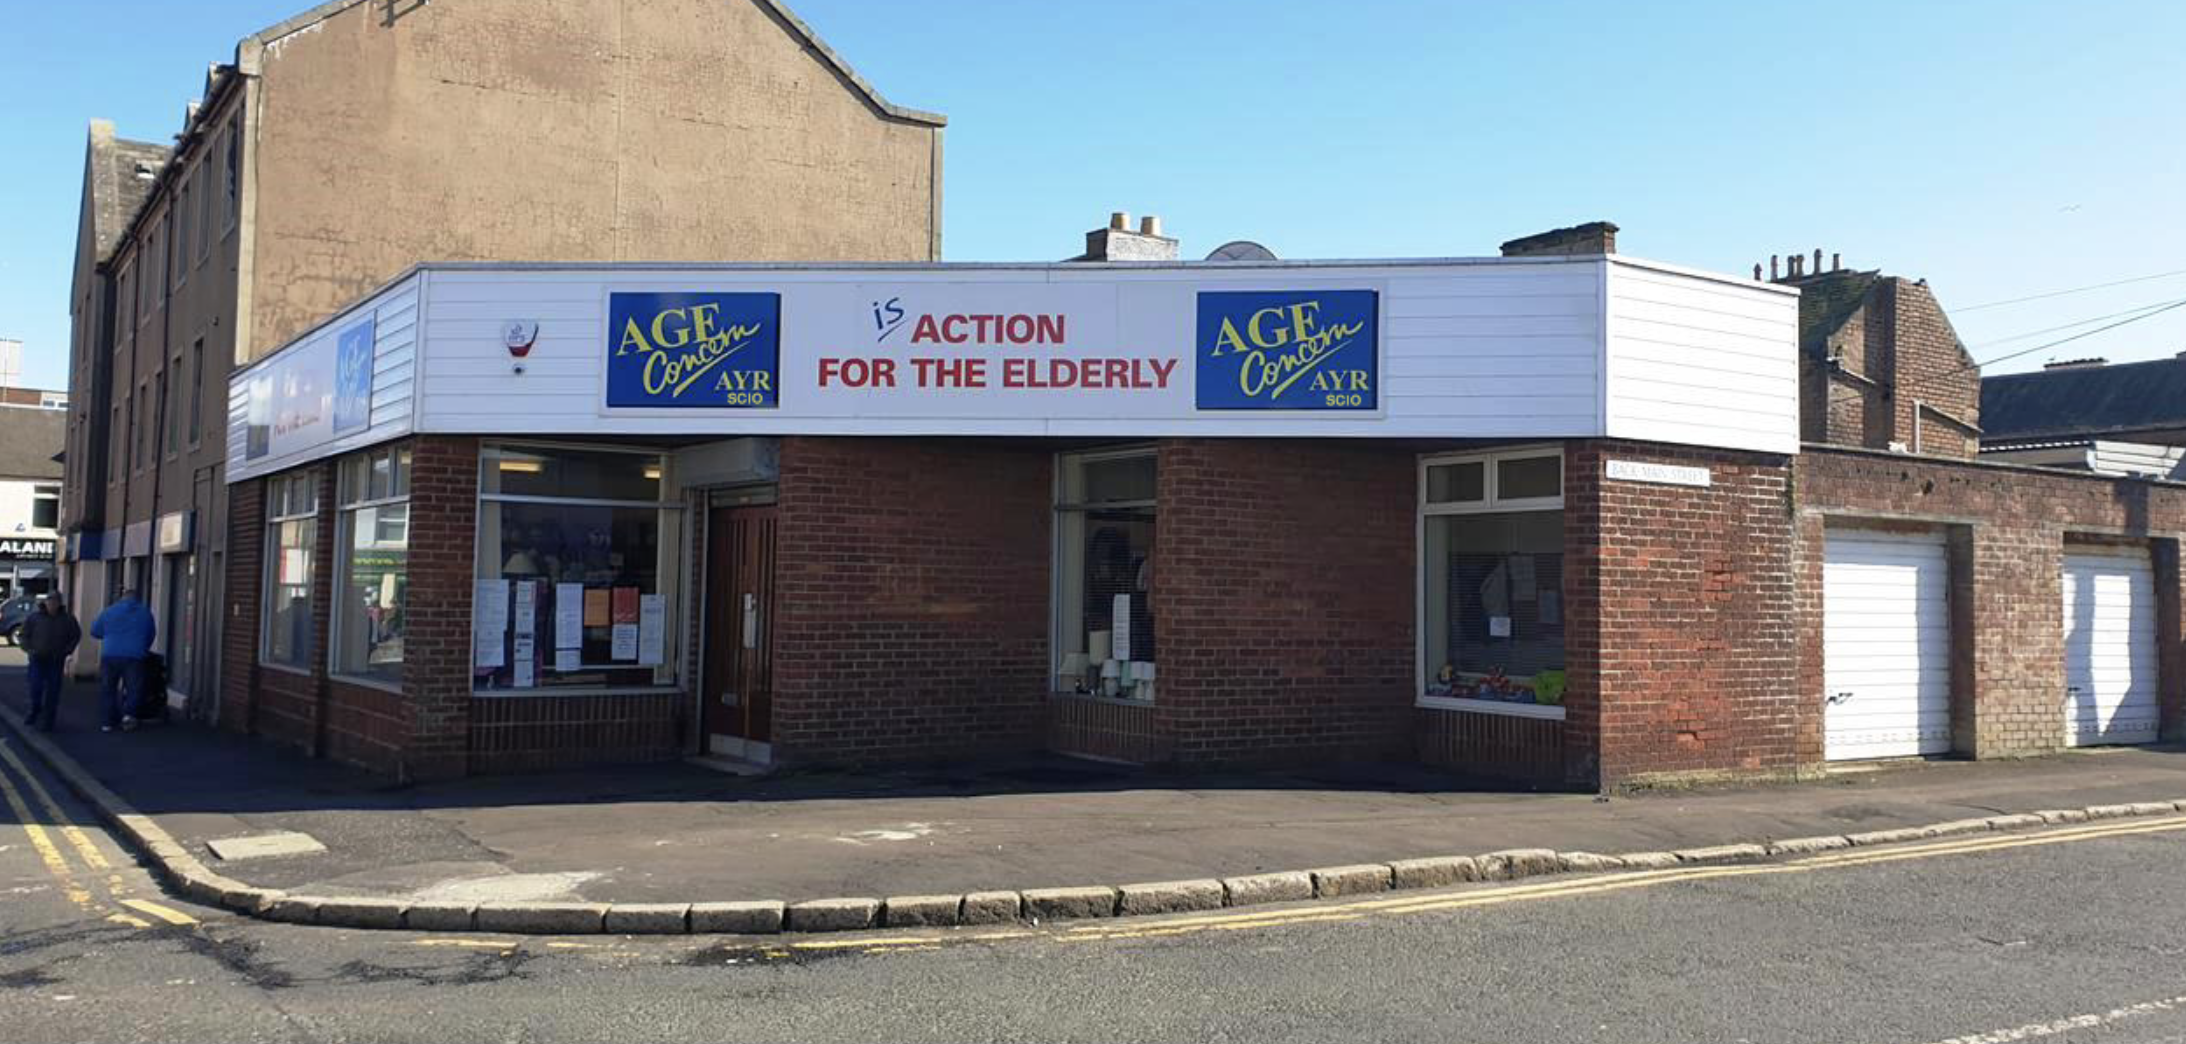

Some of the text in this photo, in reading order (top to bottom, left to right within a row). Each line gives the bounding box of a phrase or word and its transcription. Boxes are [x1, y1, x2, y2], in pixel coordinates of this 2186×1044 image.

[616, 302, 721, 356] AGE
[872, 297, 1066, 344] is ACTION
[1210, 301, 1321, 356] AGE
[642, 322, 762, 395] Concern
[817, 357, 1179, 389] FOR THE ELDERLY
[1239, 320, 1365, 397] Concern
[714, 370, 772, 391] AYR
[1308, 369, 1369, 391] AYR
[727, 392, 764, 405] SCIO
[1325, 394, 1362, 407] SCIO
[1671, 469, 1704, 482] STREET
